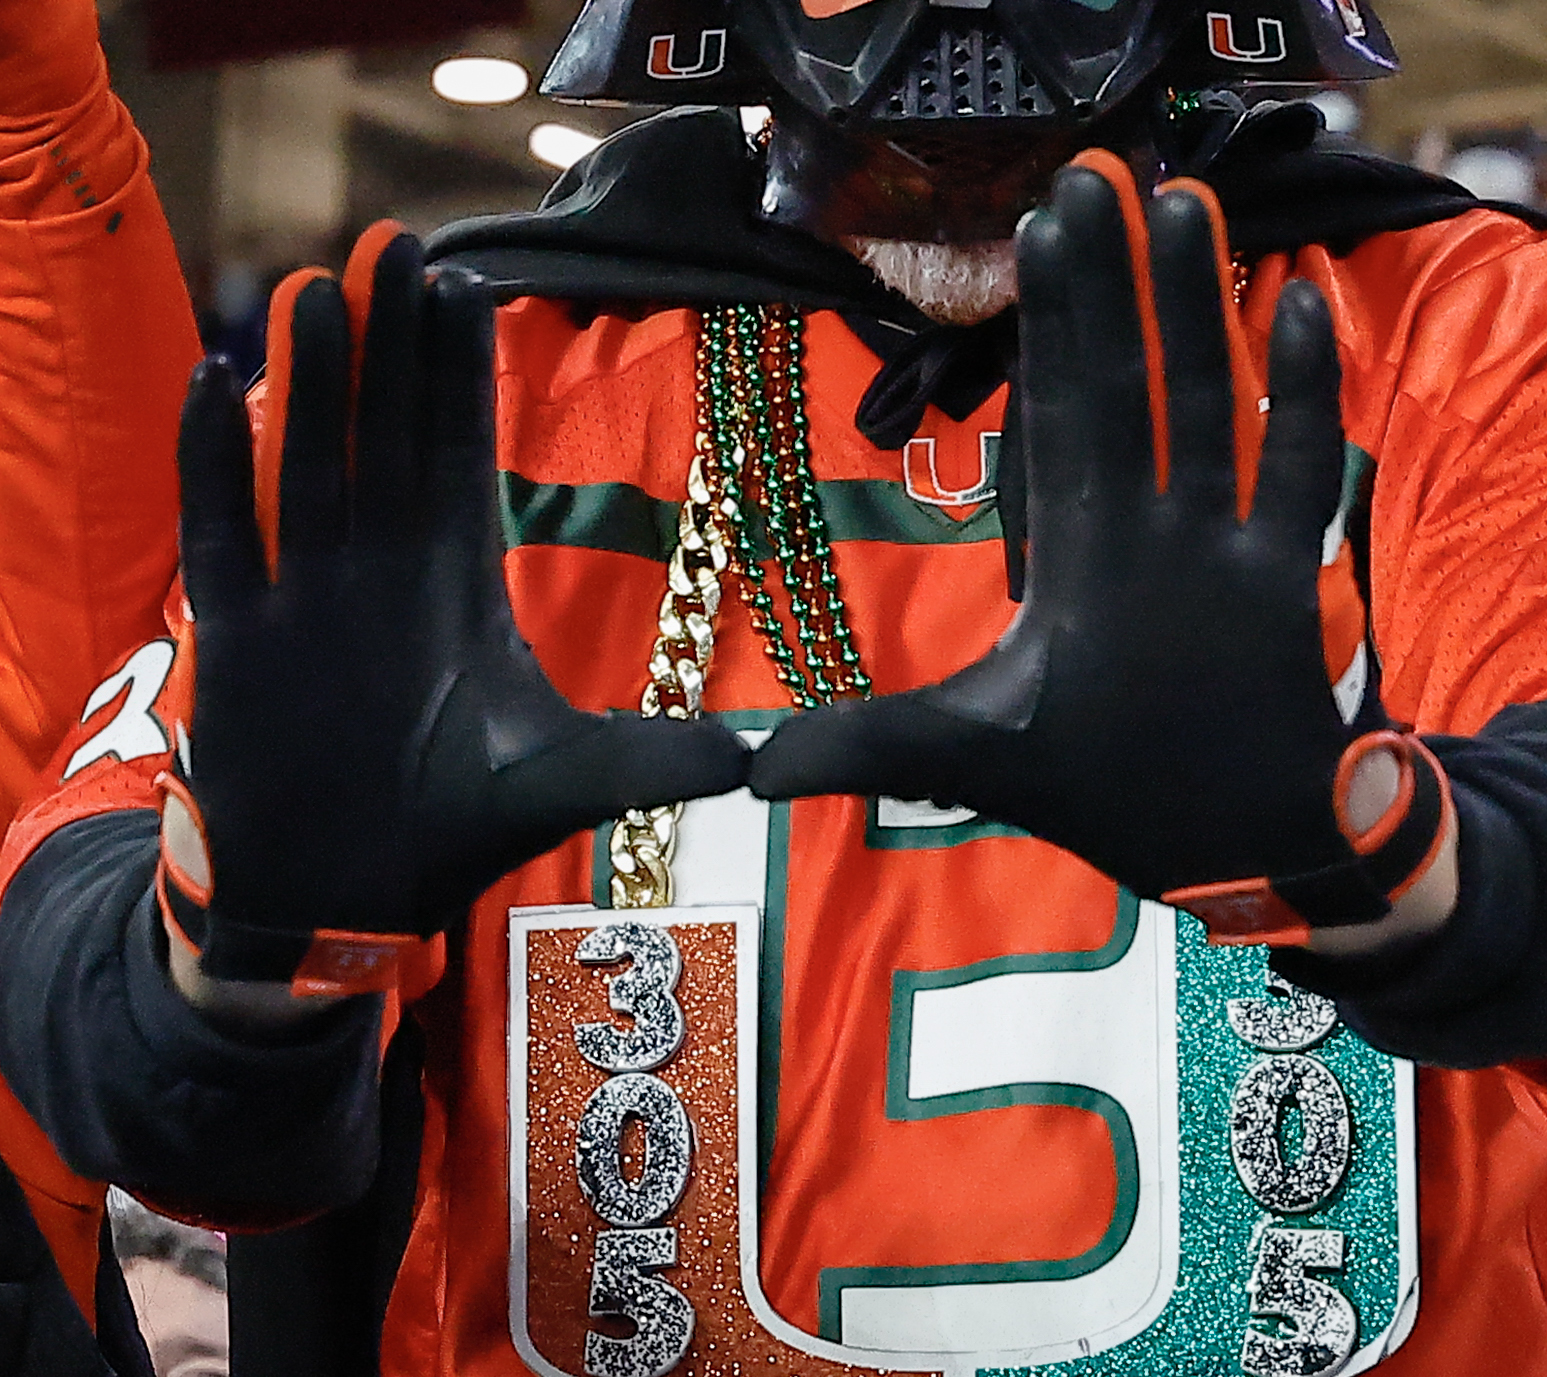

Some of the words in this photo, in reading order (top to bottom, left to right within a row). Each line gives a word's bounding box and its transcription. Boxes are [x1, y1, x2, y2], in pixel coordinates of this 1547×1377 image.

[647, 29, 727, 80] U
[1206, 12, 1287, 63] U
[904, 431, 1003, 507] U
